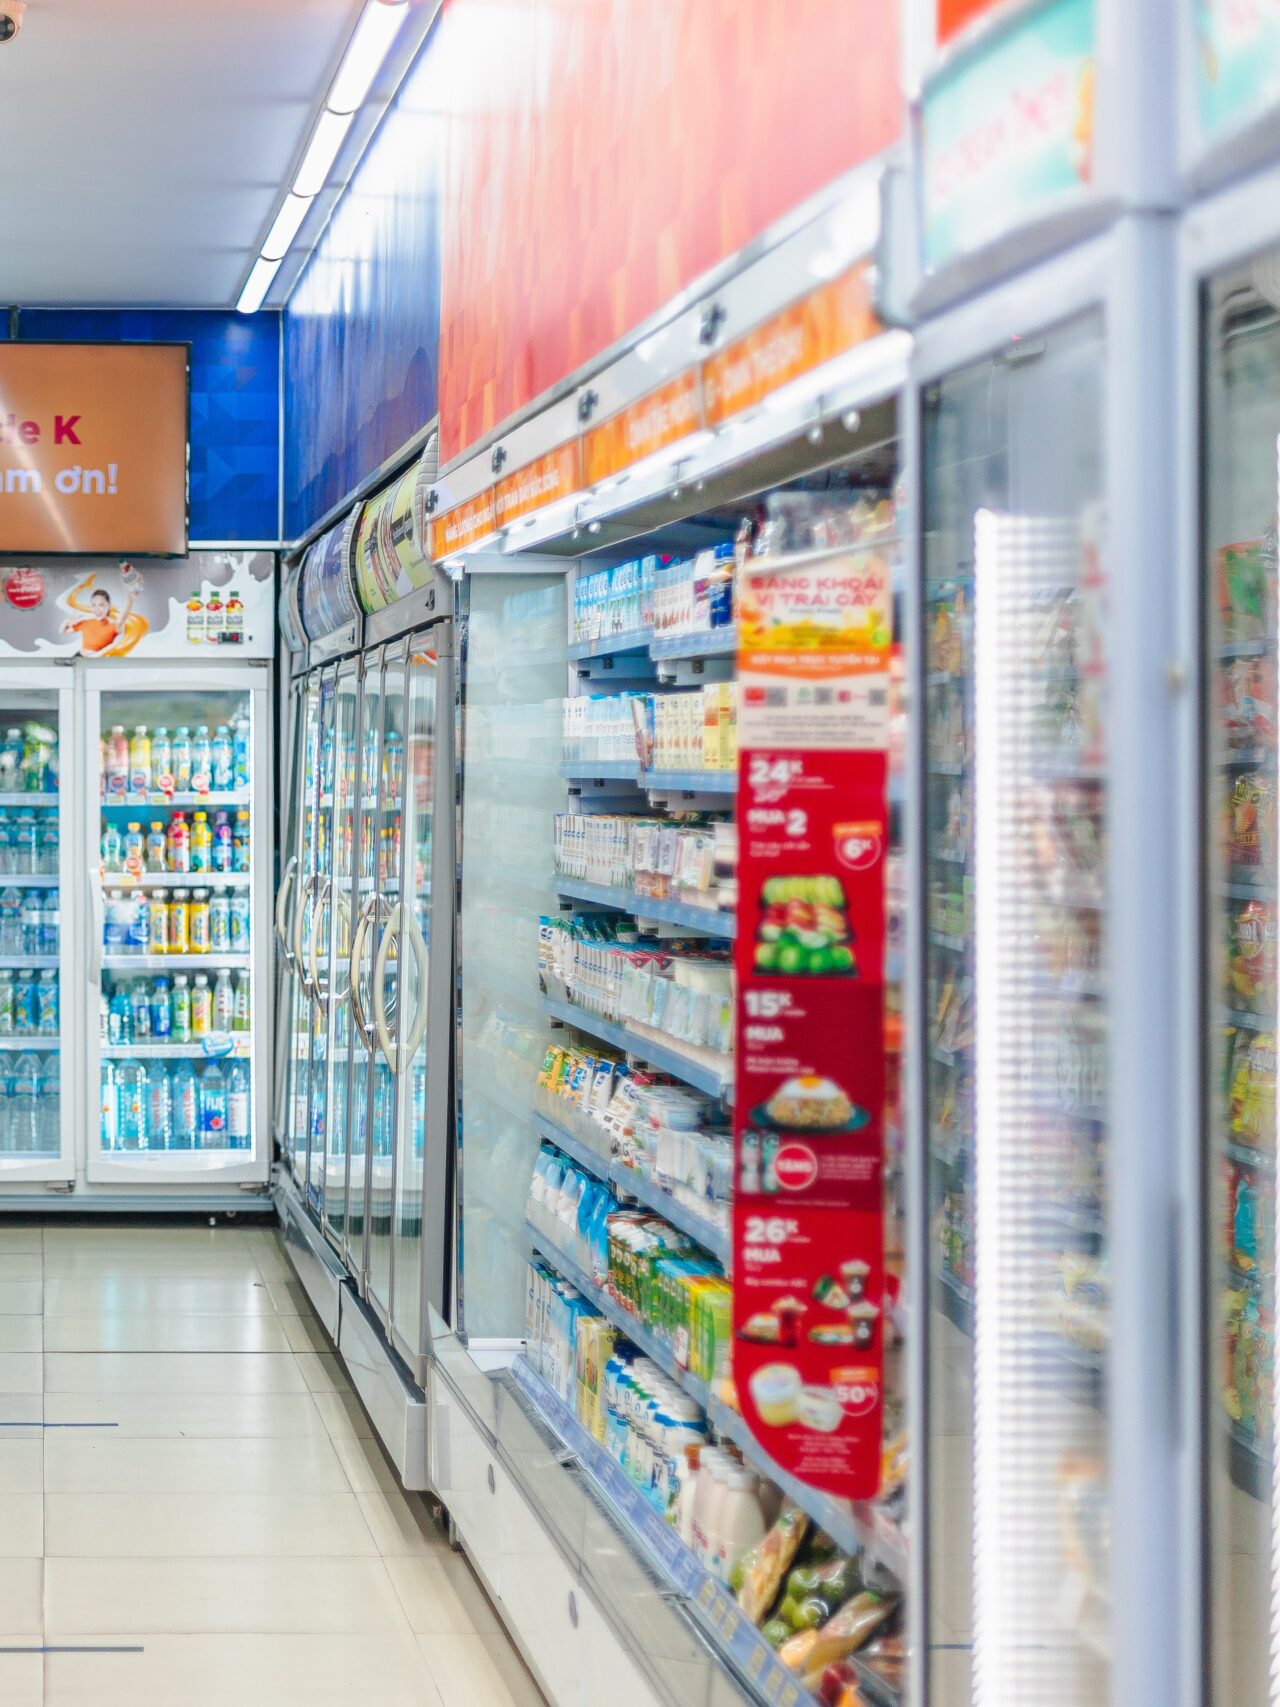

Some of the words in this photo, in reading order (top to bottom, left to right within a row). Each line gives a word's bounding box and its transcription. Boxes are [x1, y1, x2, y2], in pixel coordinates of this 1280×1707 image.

[54, 415, 82, 445] K
[55, 463, 119, 494] ơn!
[785, 808, 807, 836] 2
[743, 1247, 782, 1263] MUA
